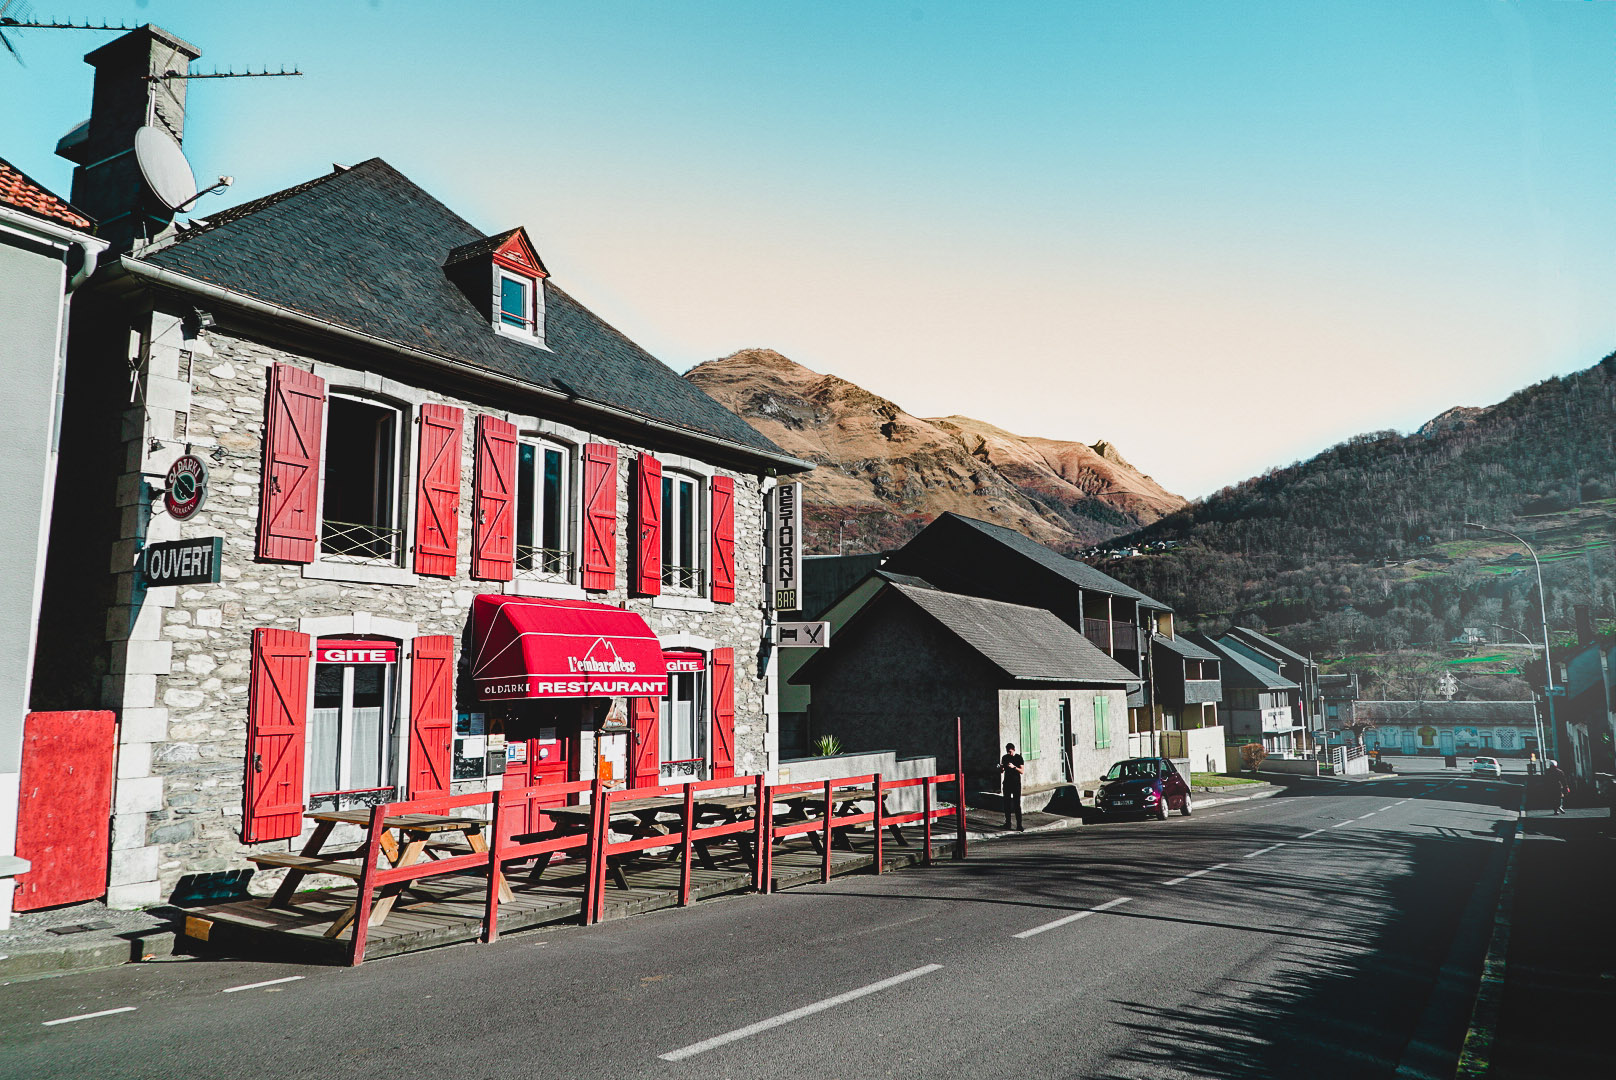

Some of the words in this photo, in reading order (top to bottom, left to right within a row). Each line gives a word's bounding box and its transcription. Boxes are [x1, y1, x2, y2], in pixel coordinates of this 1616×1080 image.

[169, 458, 201, 484] OLDARKI
[779, 485, 793, 589] RESTAURANT
[150, 545, 212, 579] OUVERT
[777, 591, 795, 608] BAR
[324, 649, 387, 661] GITE
[484, 683, 531, 694] OLDARKI
[538, 681, 666, 694] RESTAURANT
